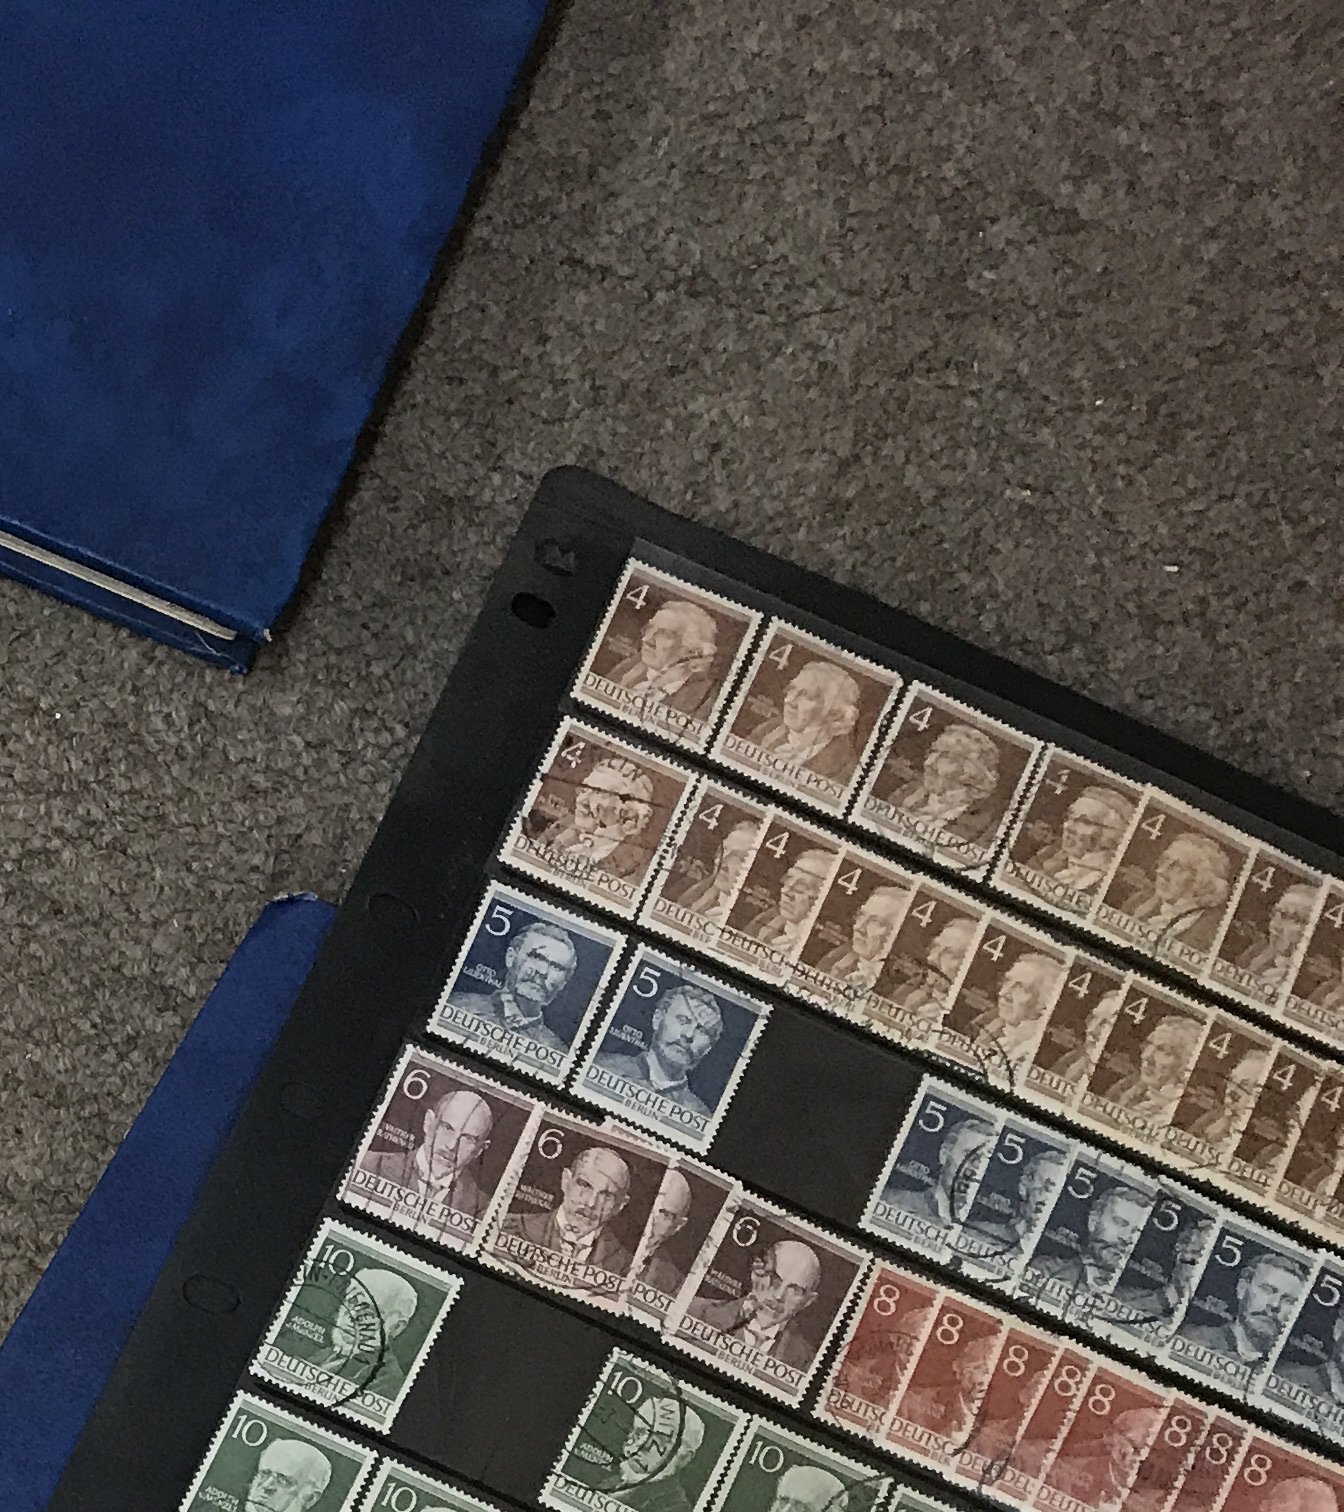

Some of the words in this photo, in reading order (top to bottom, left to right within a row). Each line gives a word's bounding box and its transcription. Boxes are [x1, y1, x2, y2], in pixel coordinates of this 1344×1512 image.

[485, 903, 513, 937] 5
[632, 966, 661, 999] 5
[439, 1004, 525, 1055] DEUTSCHE
[523, 1040, 566, 1068] POST
[622, 1025, 643, 1039] OTTO
[402, 1069, 431, 1100] 6
[586, 1064, 668, 1117] DEUTSCHE
[668, 1104, 711, 1133] POST
[918, 1101, 947, 1133] 5
[537, 1129, 565, 1160] 6
[997, 1133, 1026, 1165] 5
[1067, 1167, 1098, 1199] 5
[353, 1169, 439, 1221] DEUTSCHE
[439, 1207, 482, 1235] POST
[1153, 1200, 1182, 1231] 5
[318, 1244, 355, 1276] 10
[1215, 1235, 1244, 1267] 5
[873, 1284, 900, 1316] 8
[1313, 1275, 1343, 1307] 5
[936, 1313, 964, 1345] 8
[679, 1314, 763, 1366] DEUTSCHE
[762, 1356, 807, 1389] POST
[1003, 1345, 1029, 1377] 8
[611, 1371, 643, 1404] 10
[1054, 1365, 1082, 1397] 8
[1088, 1384, 1116, 1416] 8
[231, 1413, 268, 1447] 10
[1165, 1415, 1192, 1447] 8
[748, 1441, 784, 1473] 10
[1243, 1454, 1273, 1486] 8
